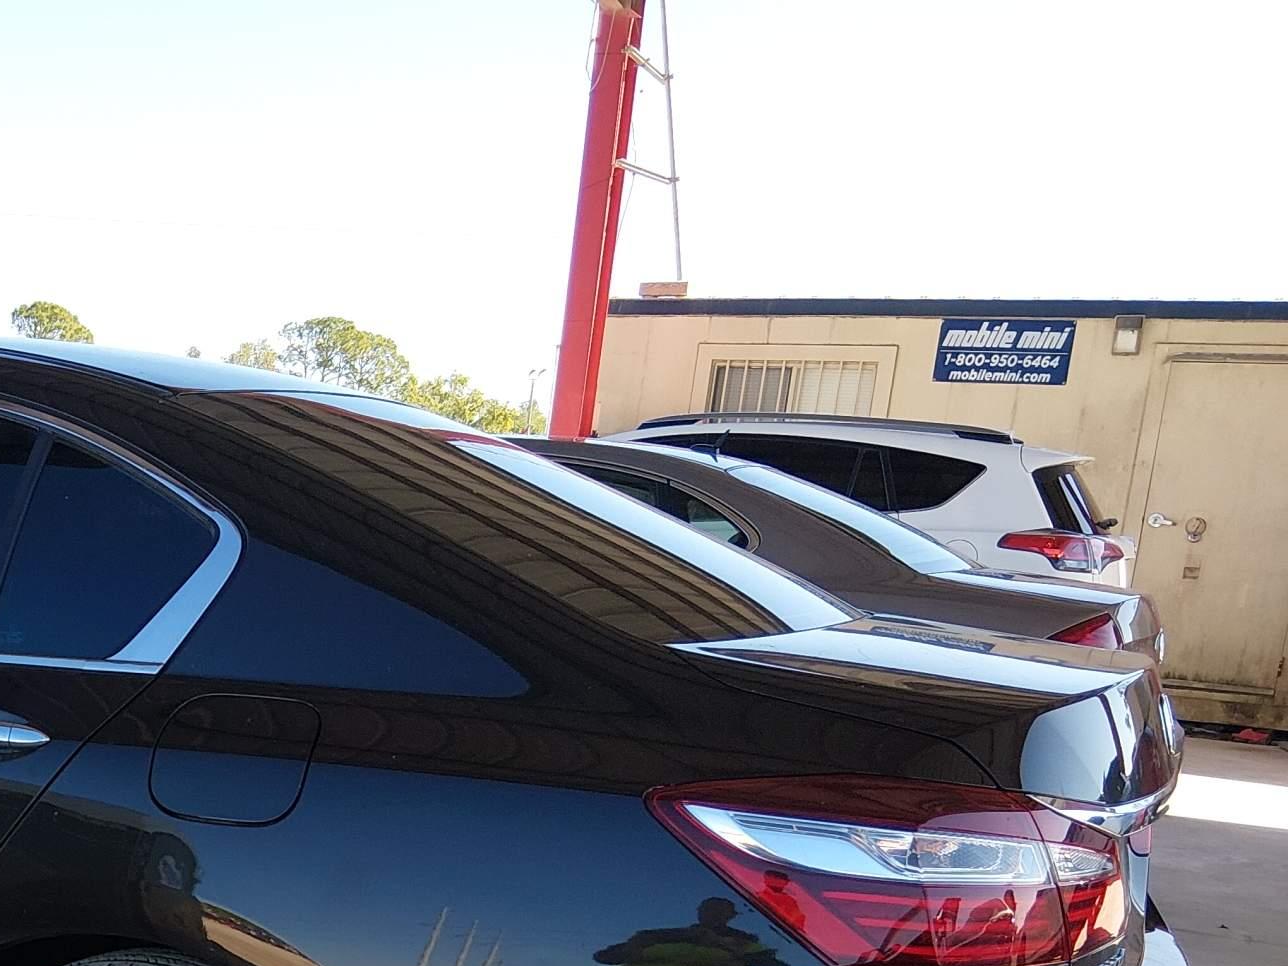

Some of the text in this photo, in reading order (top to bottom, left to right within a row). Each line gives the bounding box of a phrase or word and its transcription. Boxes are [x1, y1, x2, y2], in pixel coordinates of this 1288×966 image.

[941, 321, 1071, 350] mobile mini
[944, 353, 1060, 368] 1-800-950-6464
[948, 368, 1051, 383] mobilemini.com
